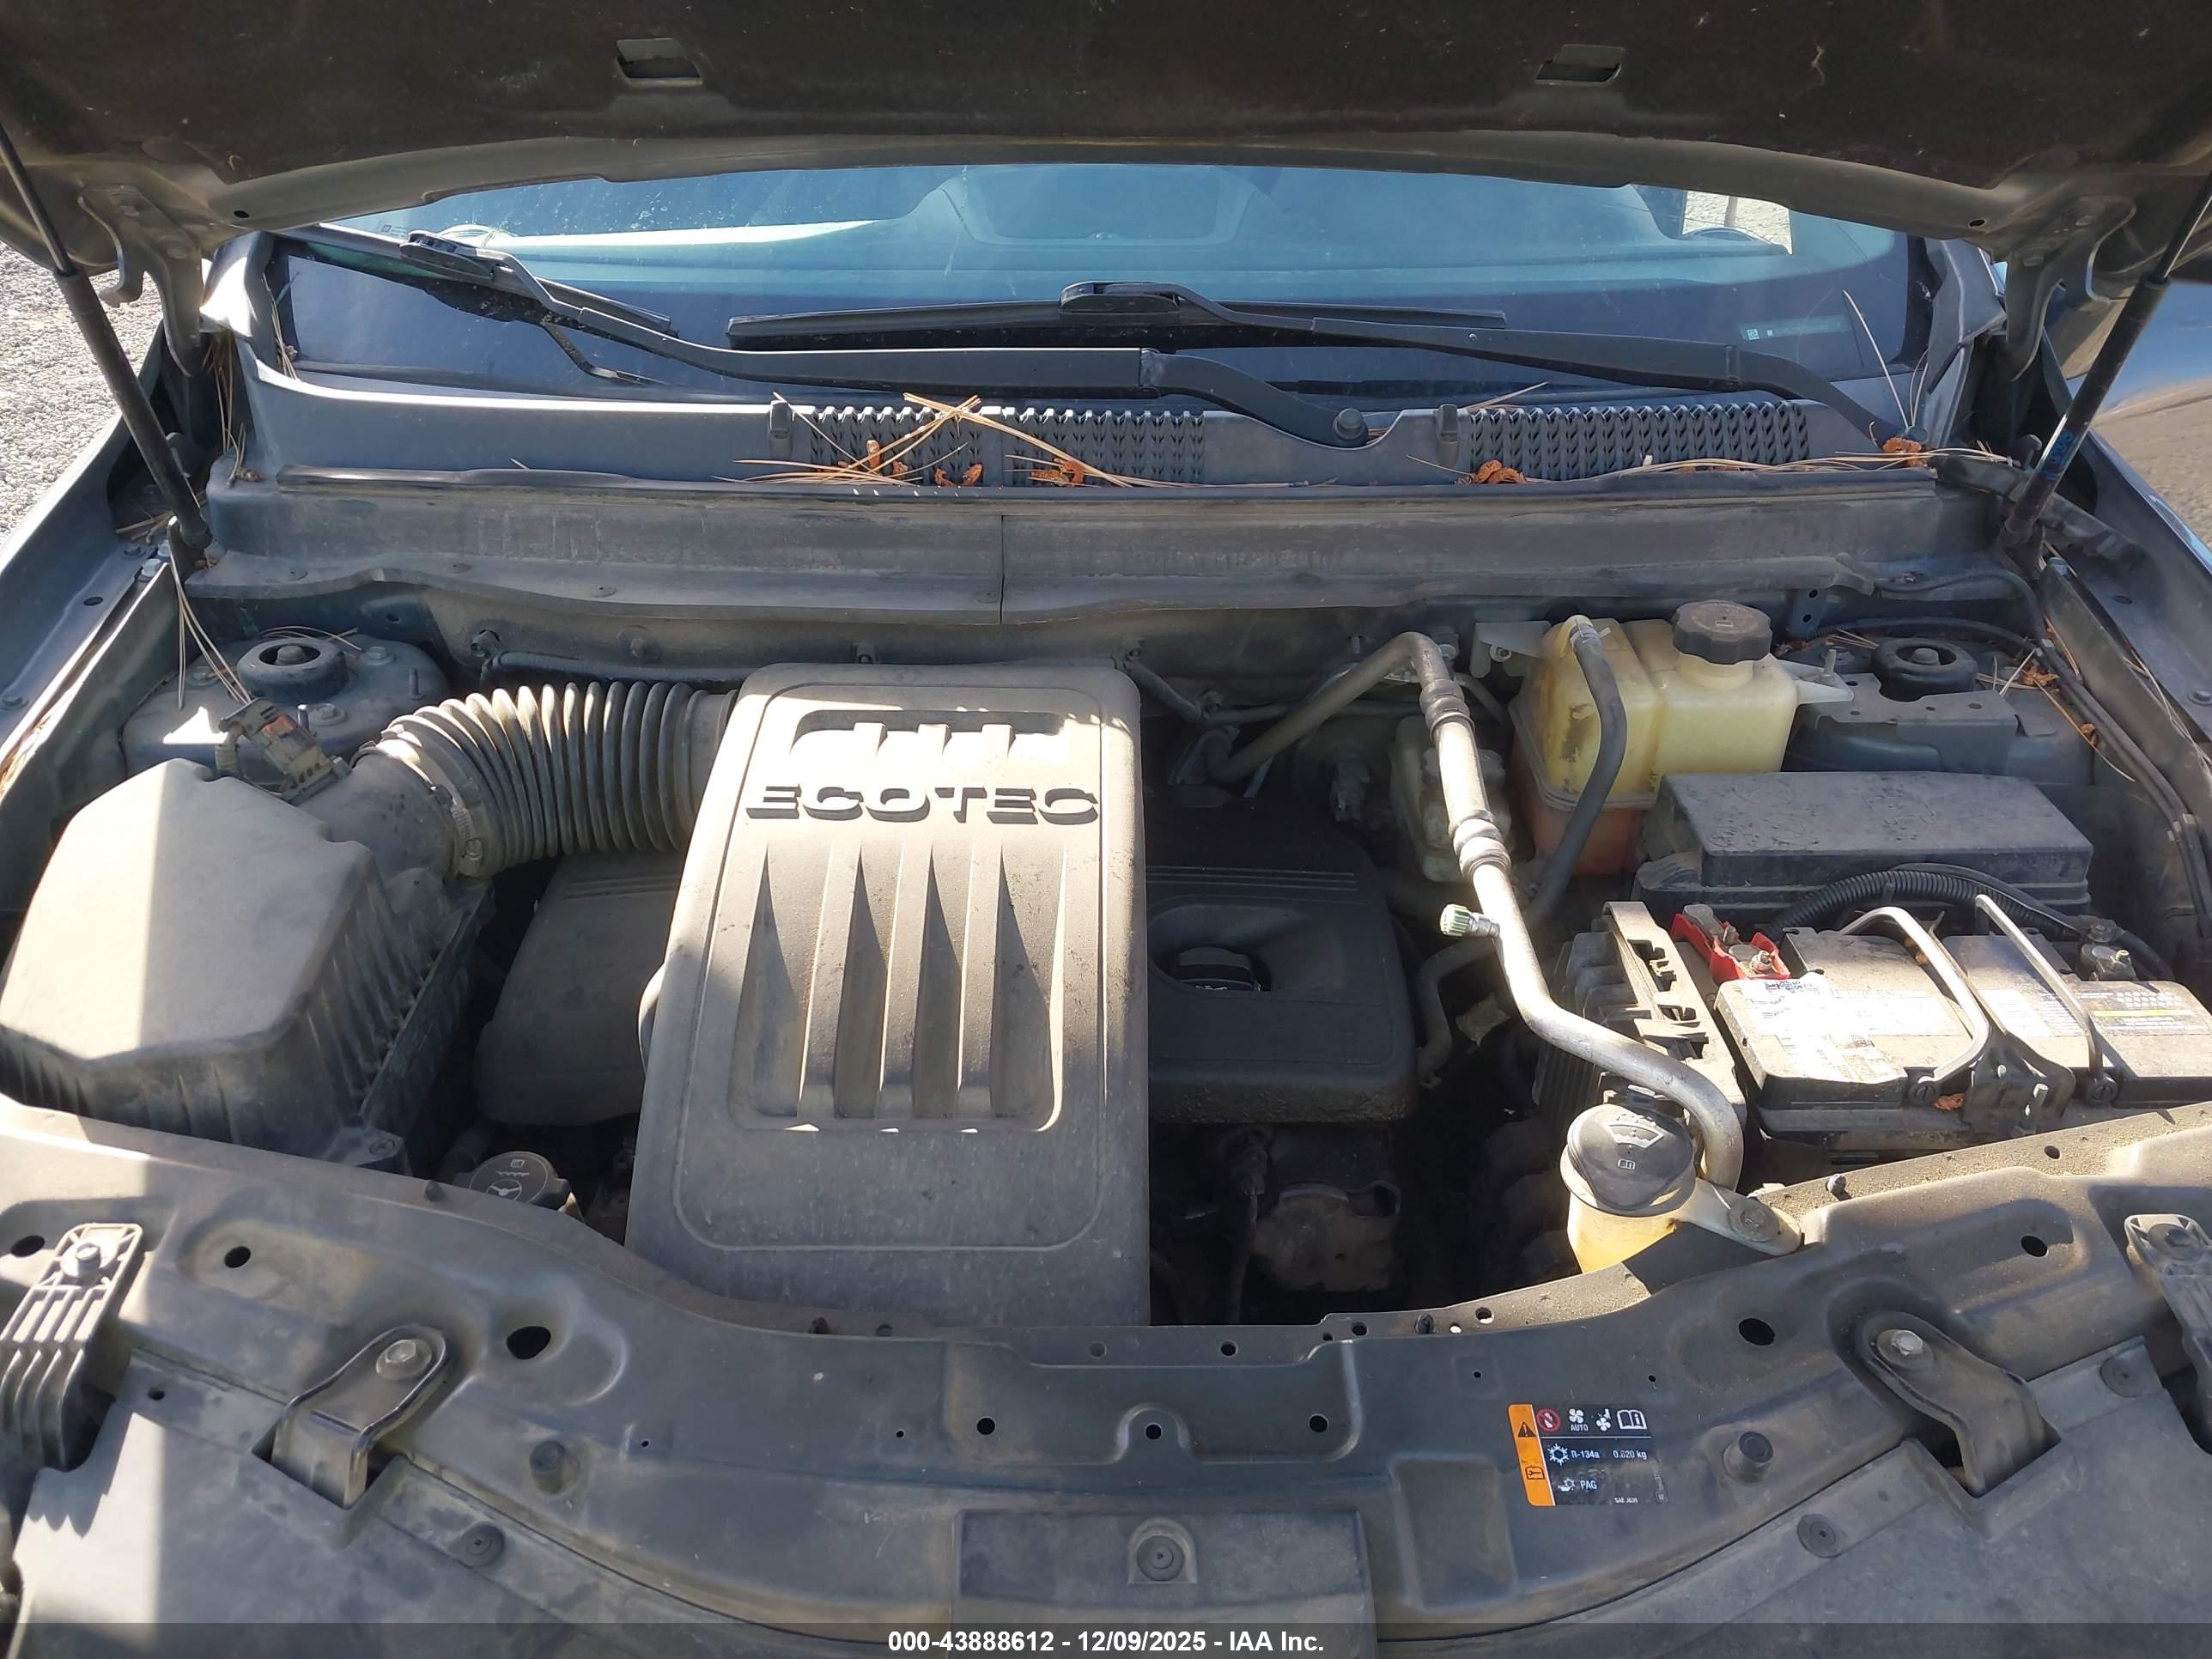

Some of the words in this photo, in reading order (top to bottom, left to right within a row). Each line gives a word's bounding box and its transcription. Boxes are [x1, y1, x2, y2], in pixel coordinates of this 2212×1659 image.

[746, 783, 1098, 825] ECOTEC
[1571, 1449, 1600, 1459] R-134a
[1637, 1449, 1647, 1460] kg
[1580, 1480, 1597, 1490] PAG
